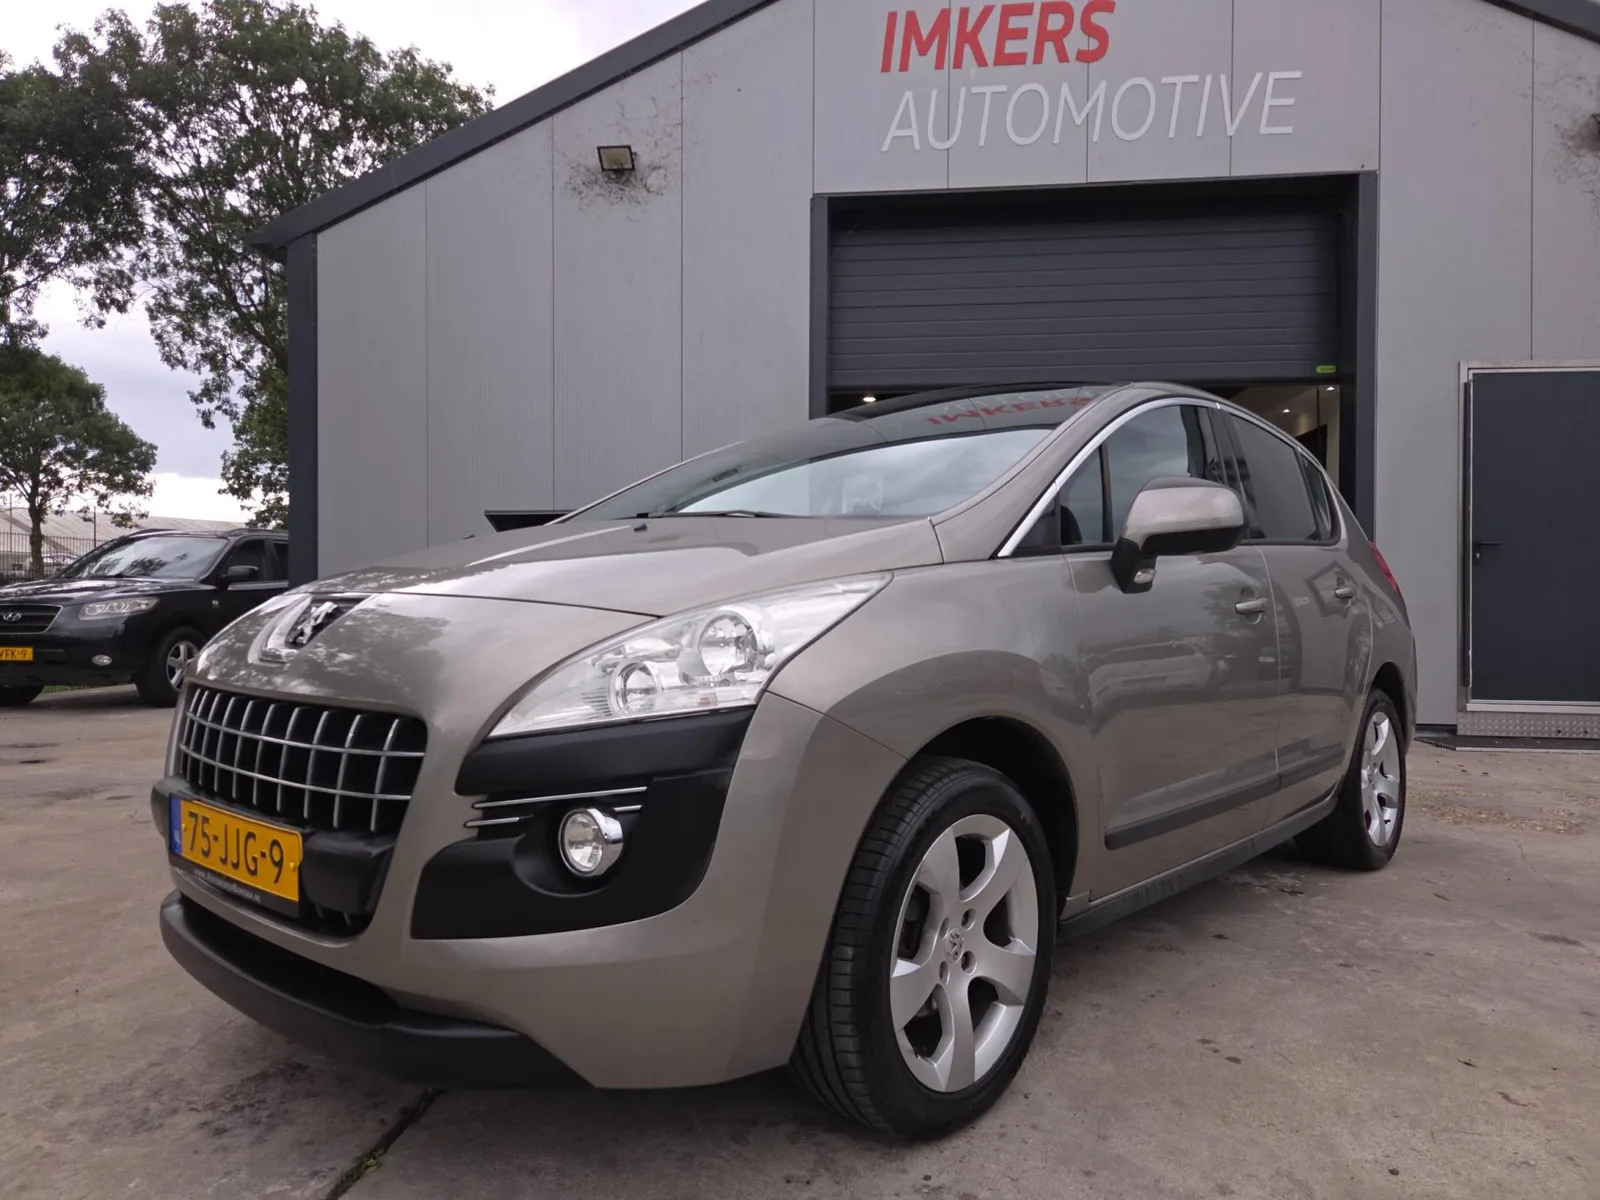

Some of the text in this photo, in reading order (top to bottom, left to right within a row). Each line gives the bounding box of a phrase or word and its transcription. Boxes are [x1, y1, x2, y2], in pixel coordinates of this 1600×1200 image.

[881, 0, 1115, 73] IMKERS
[881, 71, 1302, 152] AUTOMOTIVE
[188, 811, 284, 884] 75-JJG-9
